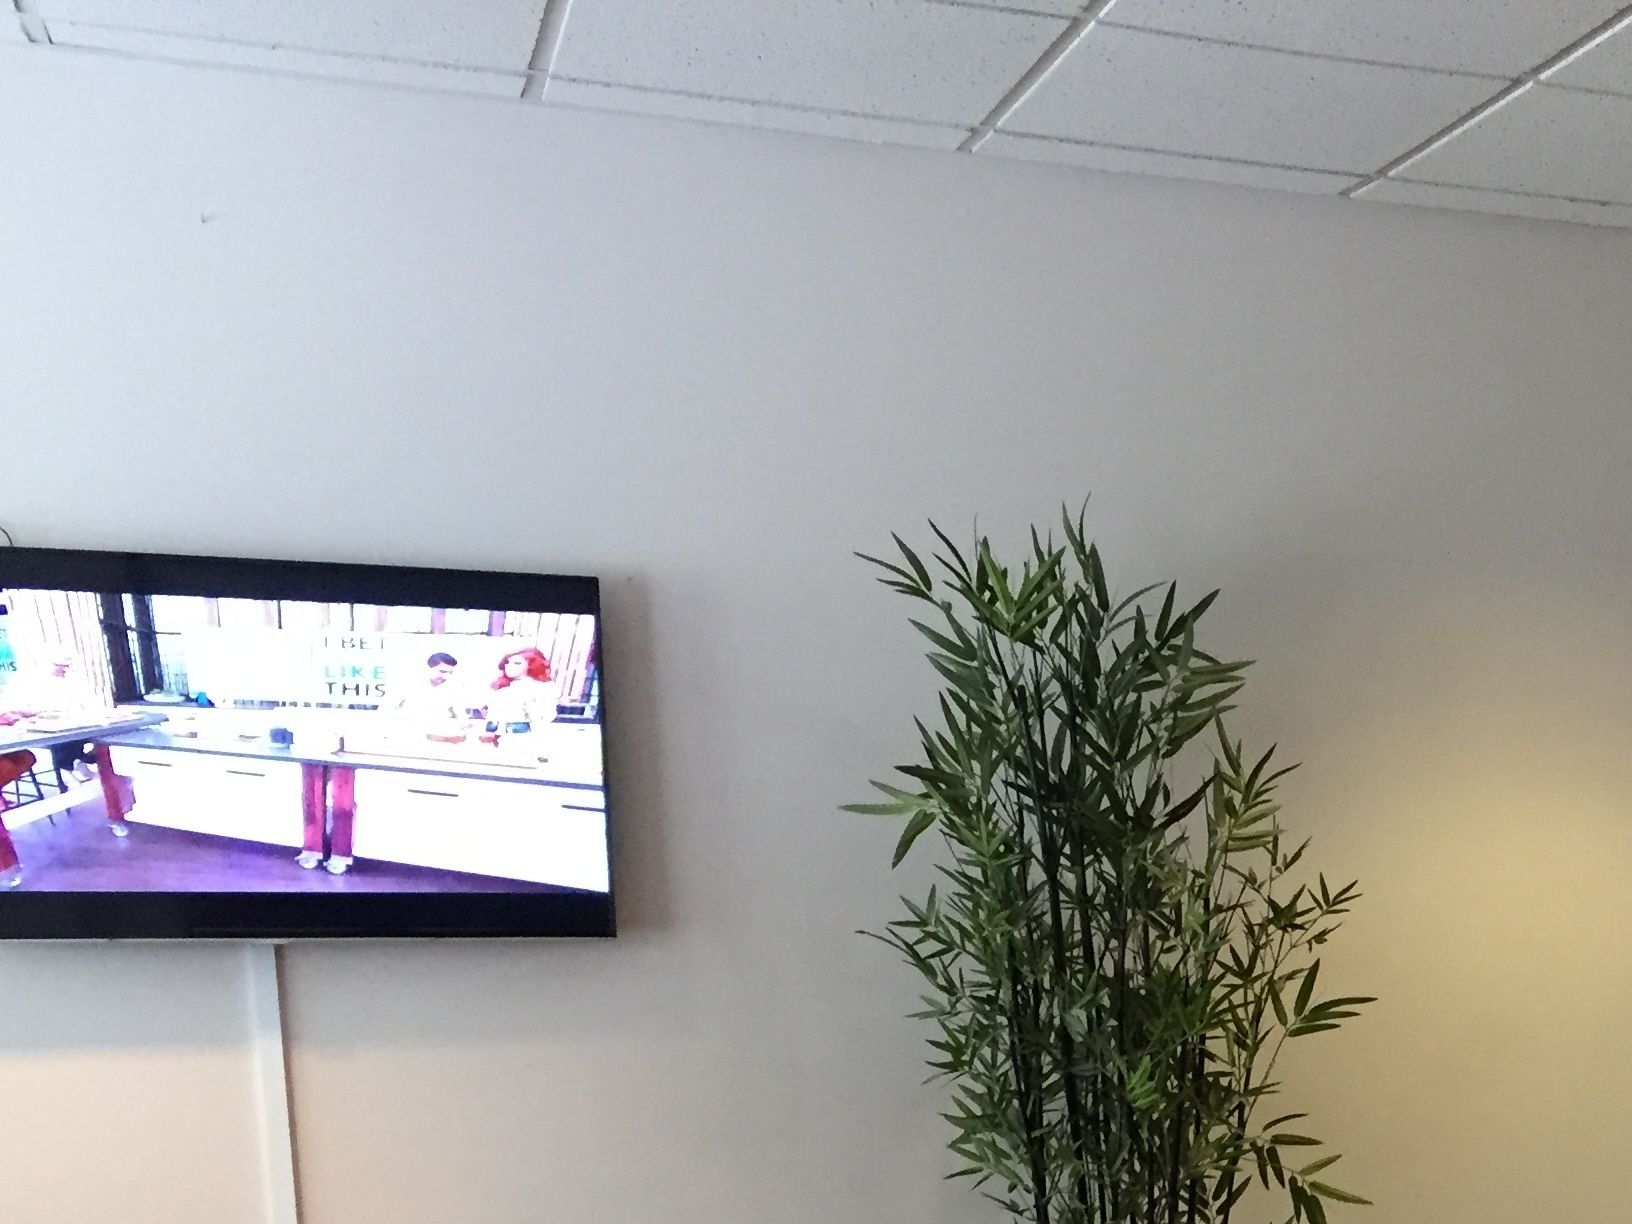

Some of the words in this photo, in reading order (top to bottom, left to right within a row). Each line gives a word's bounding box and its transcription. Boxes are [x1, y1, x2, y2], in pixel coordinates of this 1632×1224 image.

[341, 636, 385, 650] BET
[323, 664, 386, 680] LIKE
[323, 681, 386, 698] THIS
